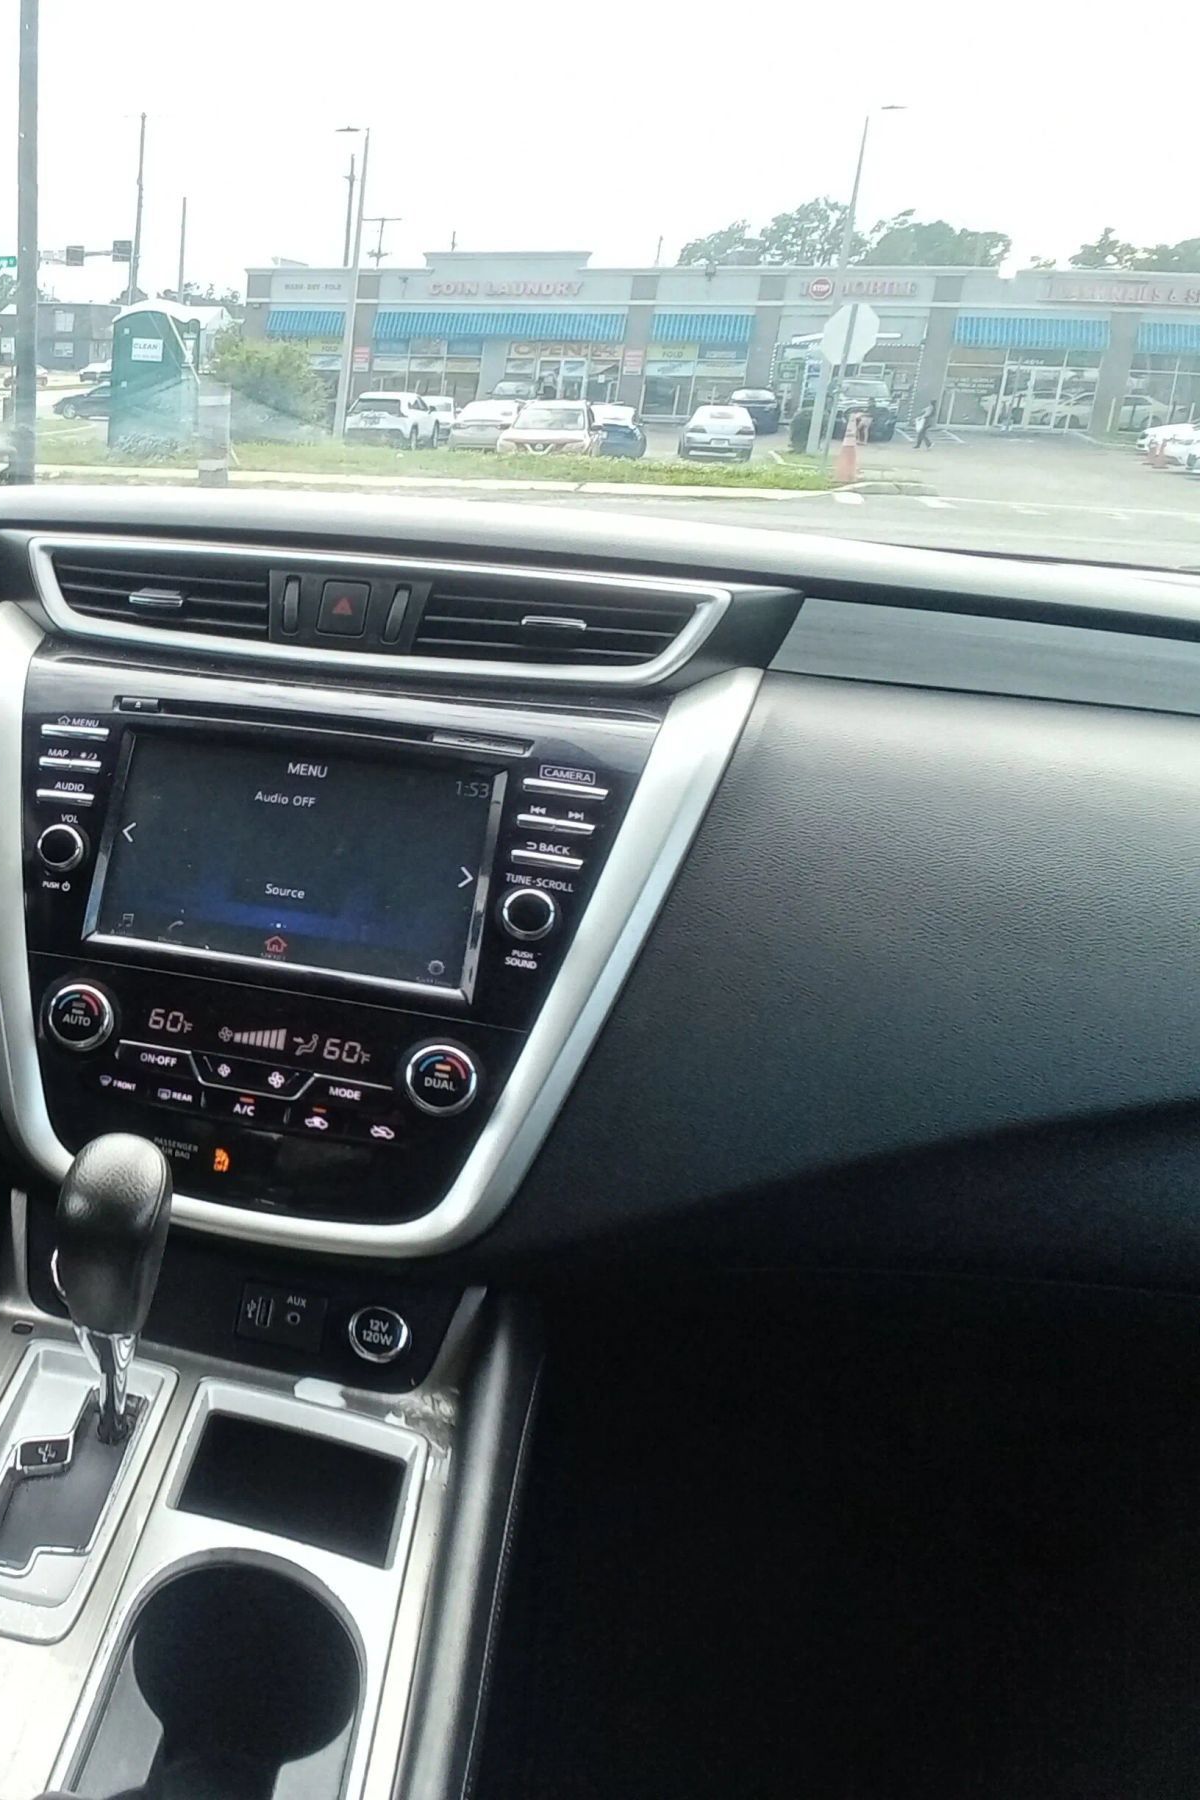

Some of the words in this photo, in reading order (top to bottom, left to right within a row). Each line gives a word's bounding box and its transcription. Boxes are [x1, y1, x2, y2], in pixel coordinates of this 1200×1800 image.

[427, 280, 479, 296] COIN
[485, 281, 584, 297] LAUNDRY
[133, 342, 158, 350] CLEAN
[513, 342, 582, 357] OPEN
[71, 718, 99, 727] MENU
[47, 748, 69, 757] MAP
[287, 762, 328, 778] MENU
[543, 767, 592, 782] CAMERA
[54, 781, 85, 792] AUDIO
[455, 780, 490, 799] 1:53
[254, 790, 289, 805] Audio
[292, 795, 316, 808] OFF
[61, 813, 79, 823] VOL
[538, 842, 571, 855] BACK
[42, 880, 60, 888] PUSH
[265, 883, 305, 899] Source
[511, 949, 534, 959] PUSH
[504, 957, 538, 970] SOUND
[62, 1013, 91, 1027] AUTO
[112, 1079, 137, 1092] FRONT
[424, 1077, 456, 1092] DUAL
[171, 1091, 193, 1103] REAR
[329, 1086, 361, 1101] MODE
[233, 1103, 255, 1117] A/C
[153, 1136, 199, 1153] PASSENGER
[287, 1295, 307, 1308] AUX
[369, 1319, 389, 1333] 12V
[362, 1329, 394, 1346] 120W
